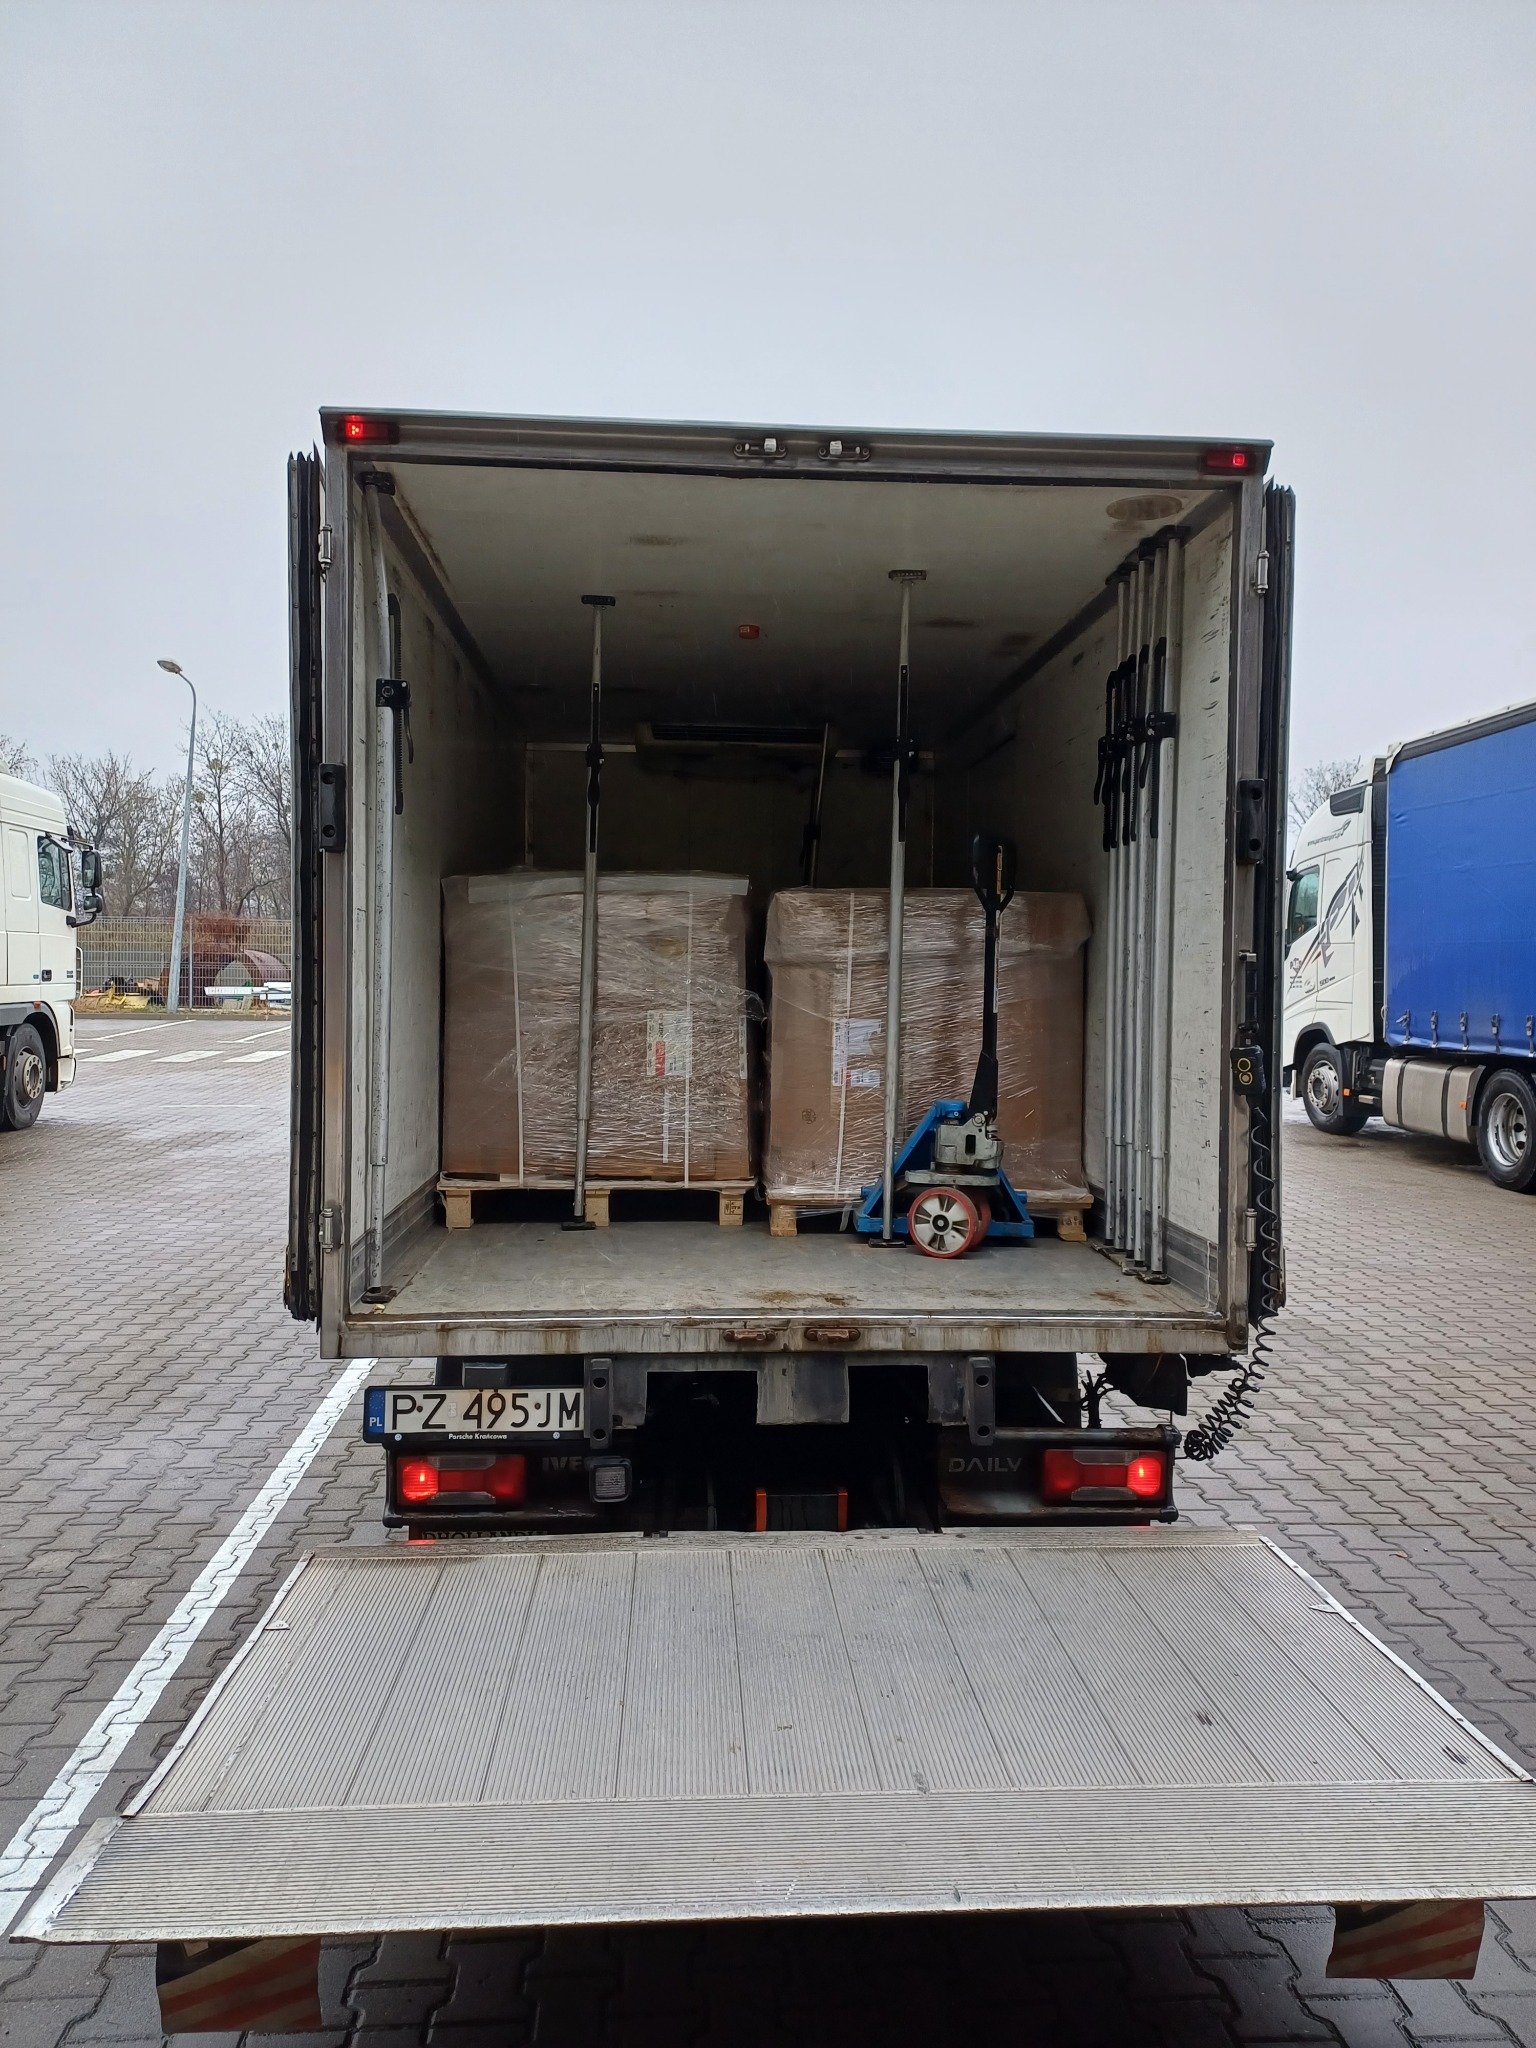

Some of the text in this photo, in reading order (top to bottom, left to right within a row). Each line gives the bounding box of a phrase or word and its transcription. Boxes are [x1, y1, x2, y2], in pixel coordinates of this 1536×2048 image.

[392, 1392, 581, 1430] PZ 495JM
[369, 1417, 382, 1427] PL
[948, 1457, 1022, 1472] DAILY
